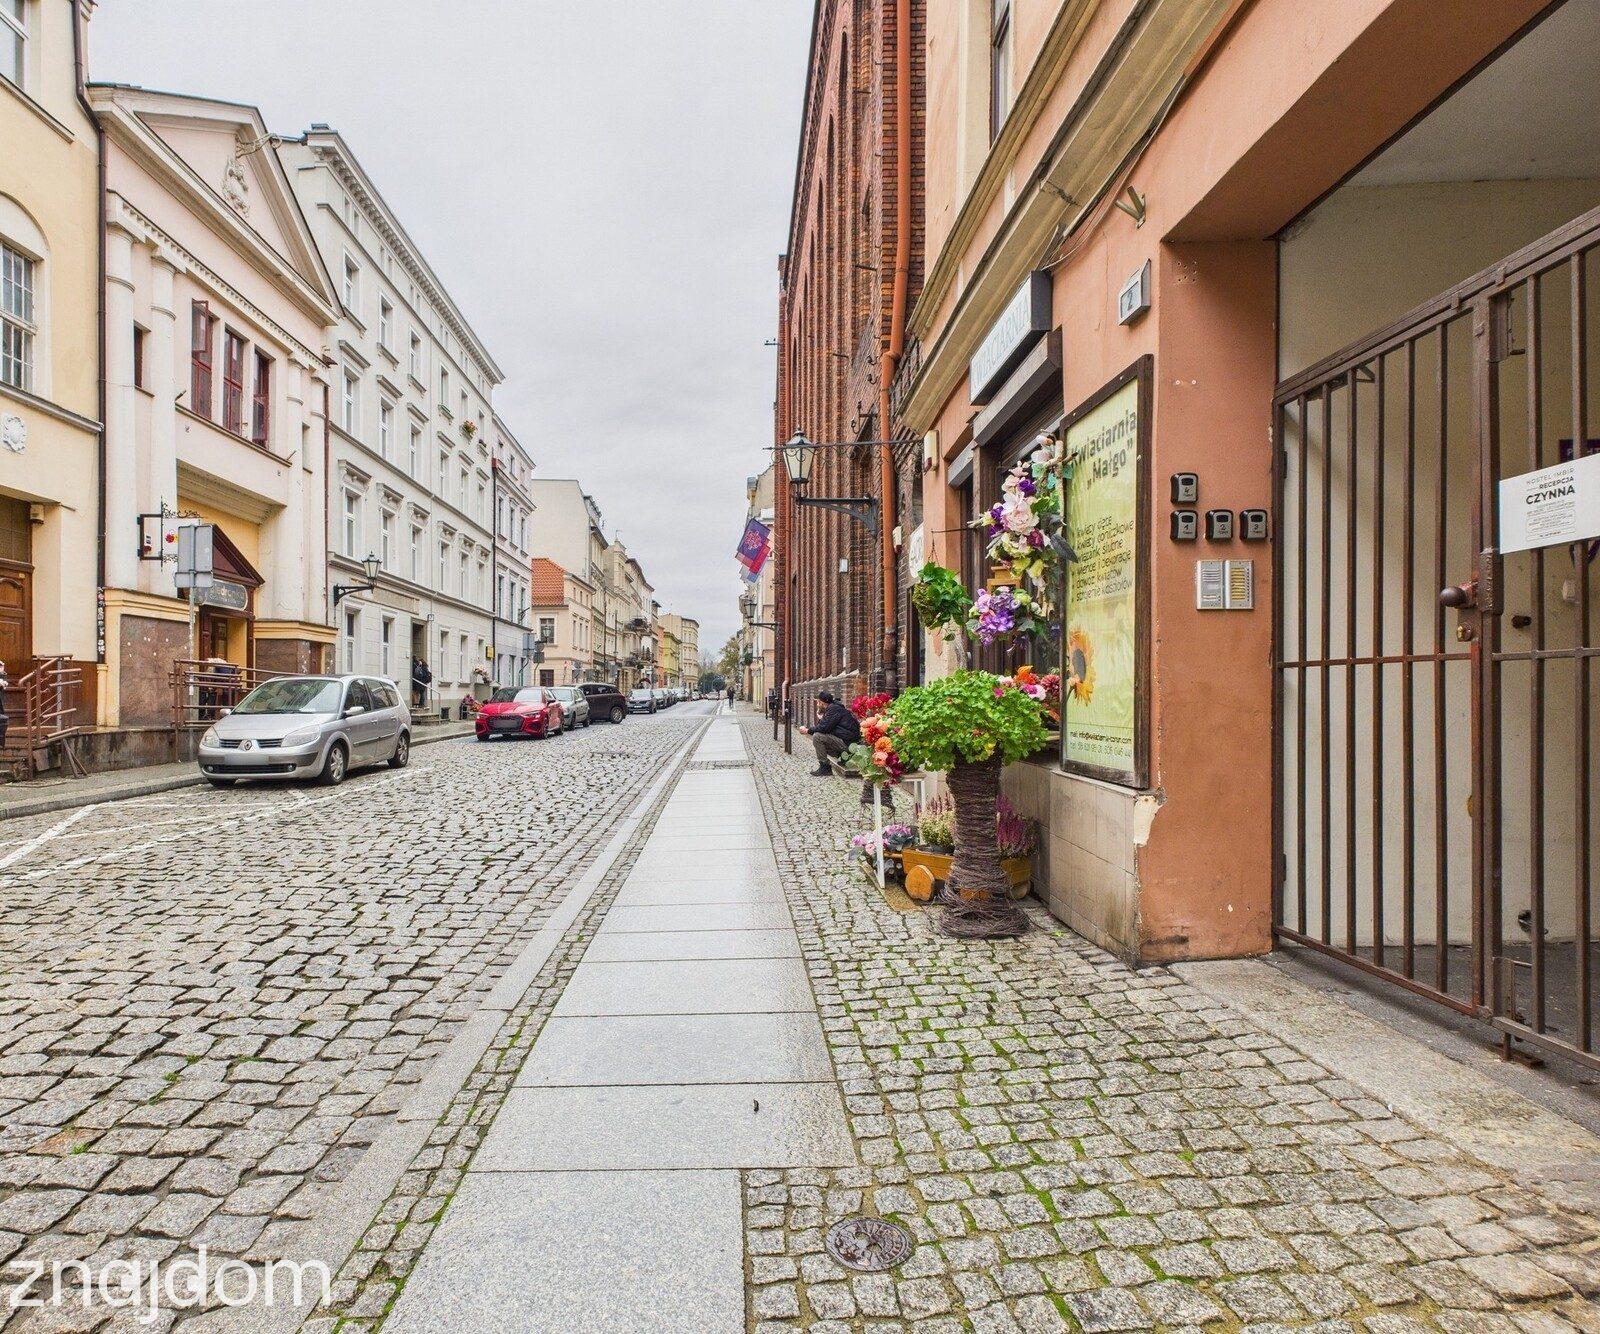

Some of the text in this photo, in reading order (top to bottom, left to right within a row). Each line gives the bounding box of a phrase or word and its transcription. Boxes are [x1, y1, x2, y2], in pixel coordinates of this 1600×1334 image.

[1126, 289, 1134, 312] 2
[1539, 475, 1575, 490] RECEPCJA
[1525, 484, 1576, 505] CZYNNA
